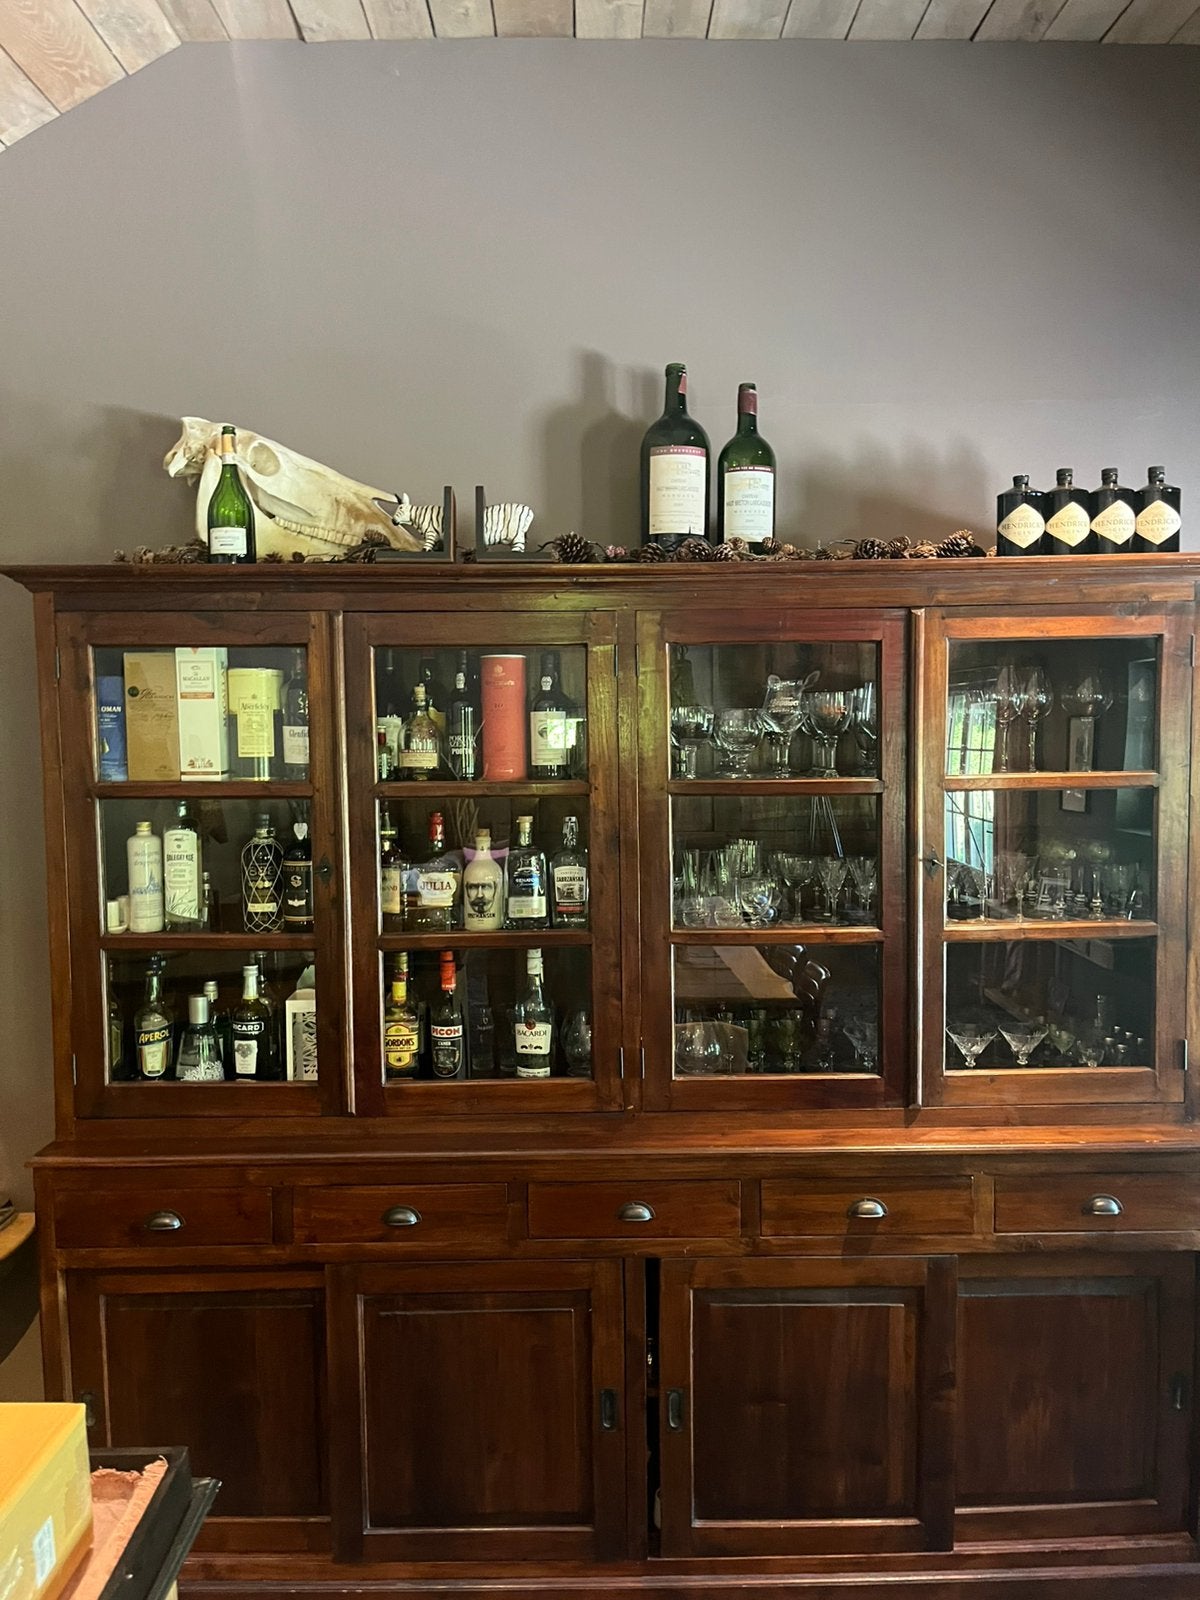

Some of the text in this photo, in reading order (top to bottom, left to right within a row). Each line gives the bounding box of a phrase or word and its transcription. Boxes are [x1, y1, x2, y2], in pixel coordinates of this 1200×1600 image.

[100, 705, 122, 713] OMAN
[420, 881, 452, 891] JULIA
[138, 1029, 170, 1044] APEROL
[517, 1029, 547, 1037] BACARDI
